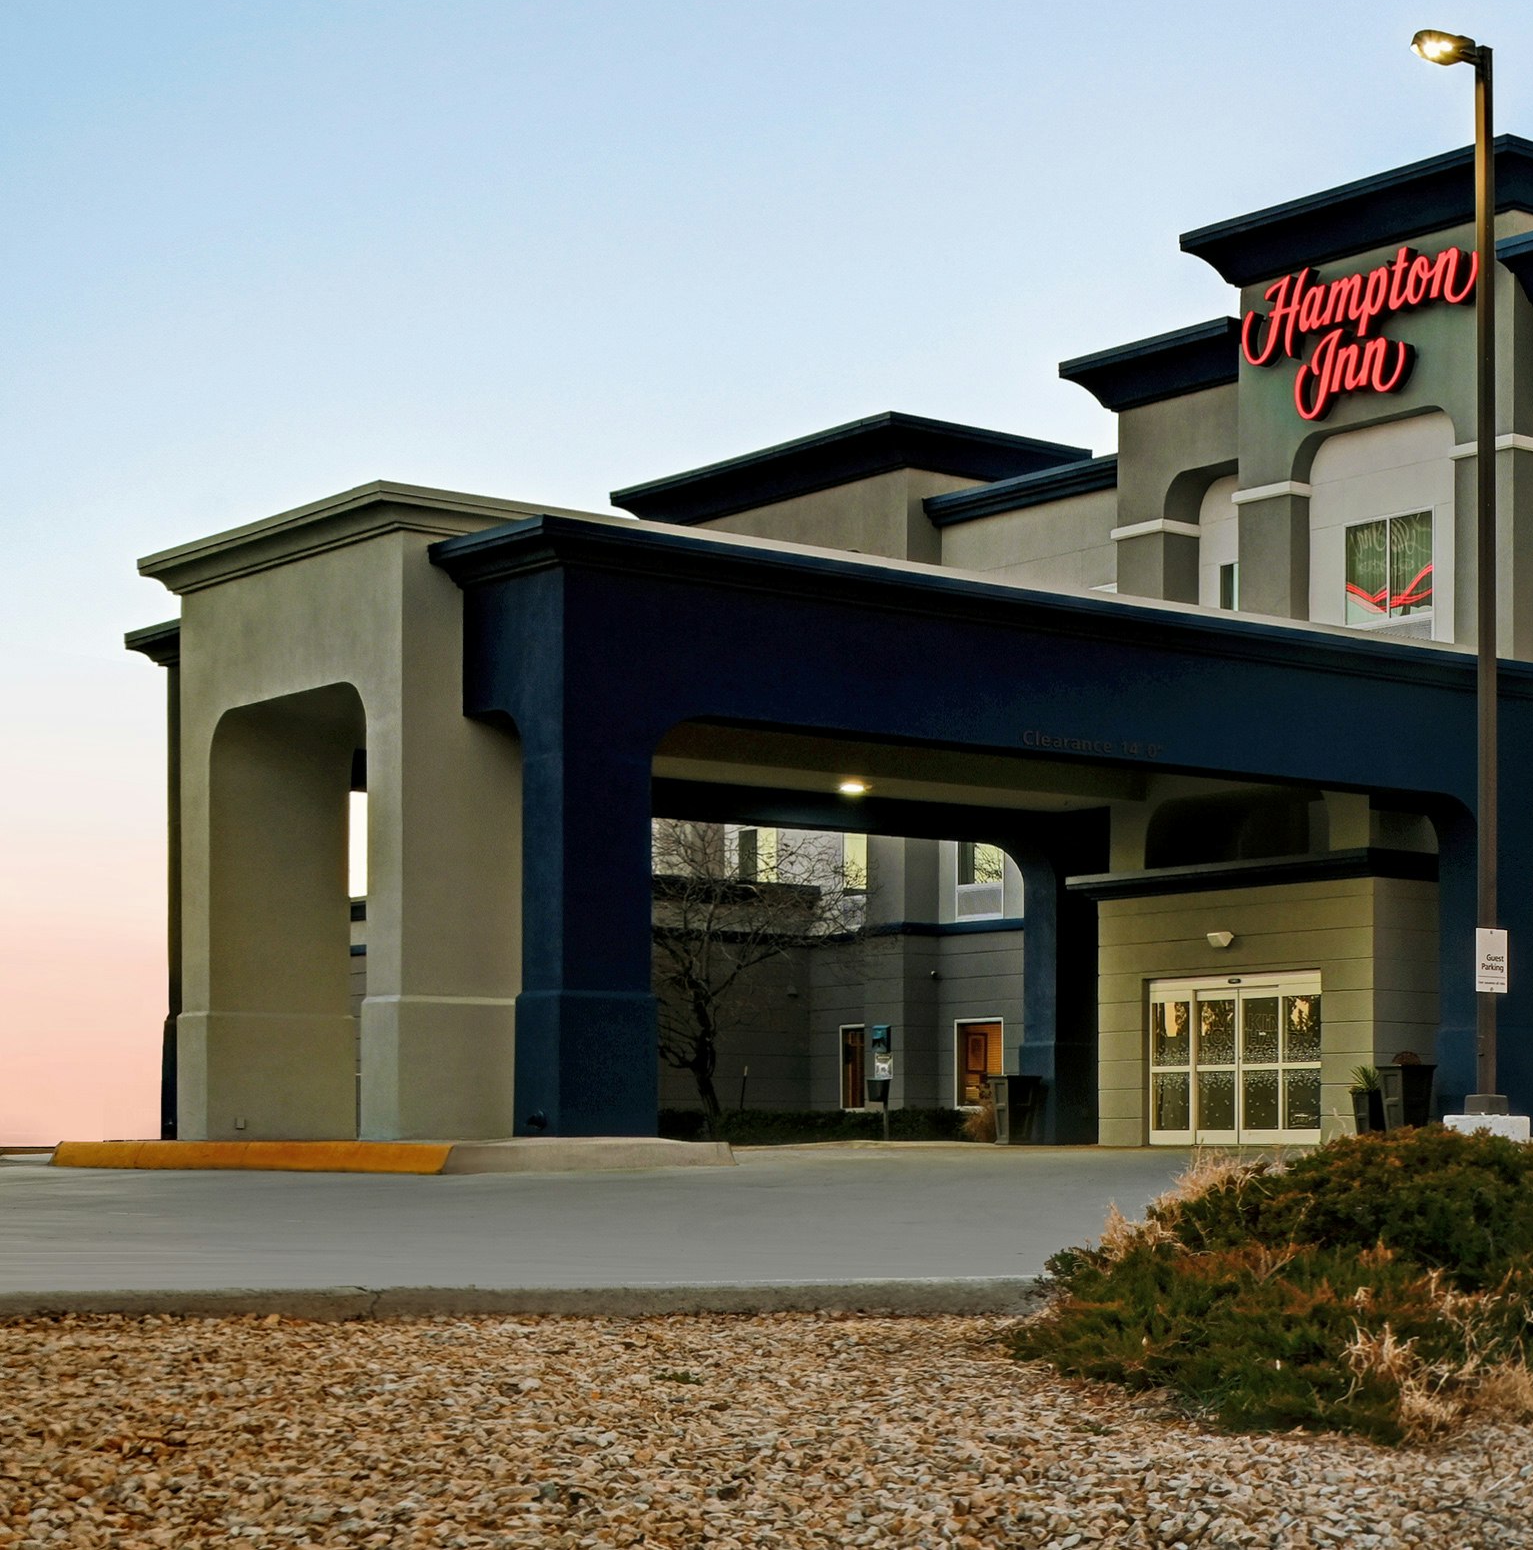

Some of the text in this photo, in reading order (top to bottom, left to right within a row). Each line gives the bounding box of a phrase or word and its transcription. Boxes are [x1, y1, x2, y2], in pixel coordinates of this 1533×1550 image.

[1241, 246, 1479, 366] Hampton
[1294, 328, 1408, 421] Inn
[1022, 730, 1112, 753] Clearance
[1481, 962, 1504, 973] Parking
[1486, 953, 1504, 962] Guest
